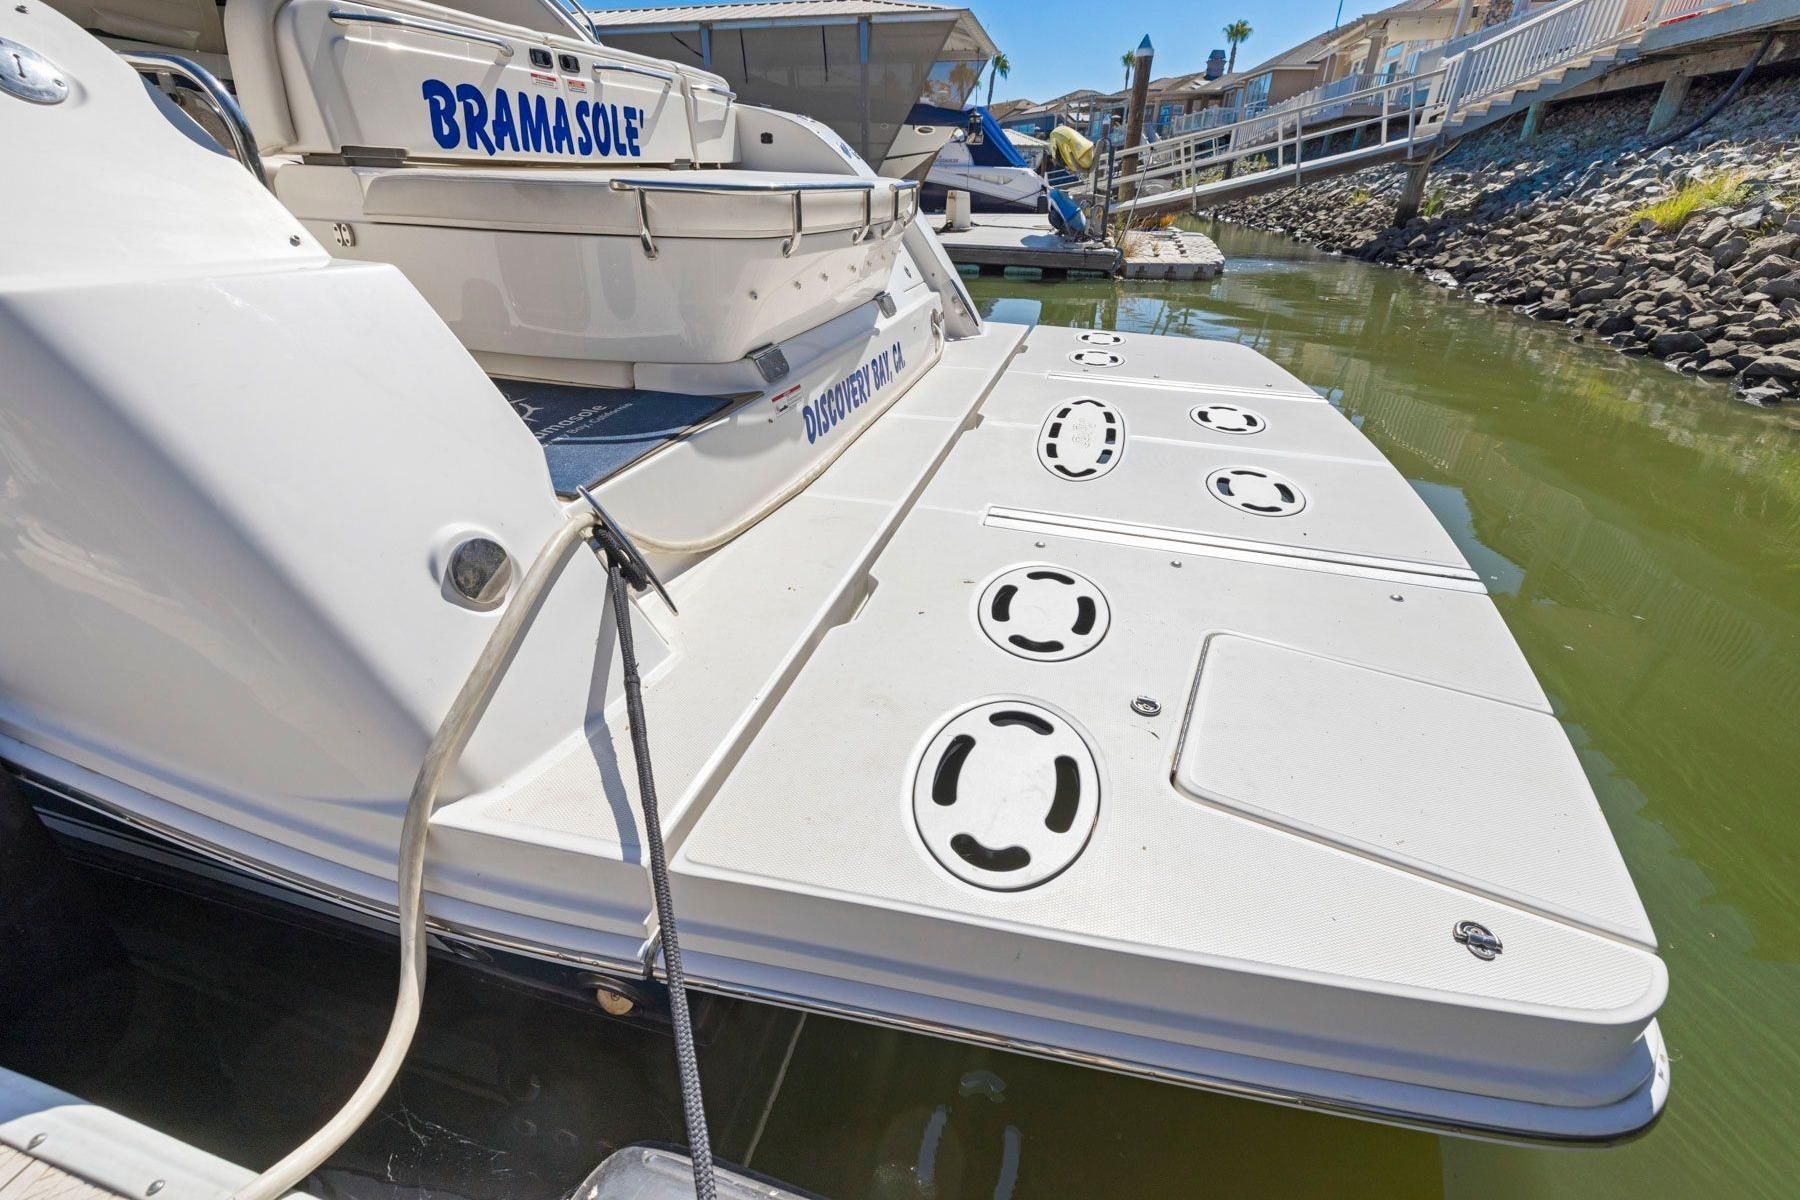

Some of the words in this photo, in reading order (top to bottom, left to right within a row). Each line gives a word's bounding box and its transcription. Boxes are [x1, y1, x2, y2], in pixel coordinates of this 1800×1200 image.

[535, 405, 607, 439] amasole
[802, 364, 871, 445] DISCOVERY
[871, 350, 893, 391] BAY,
